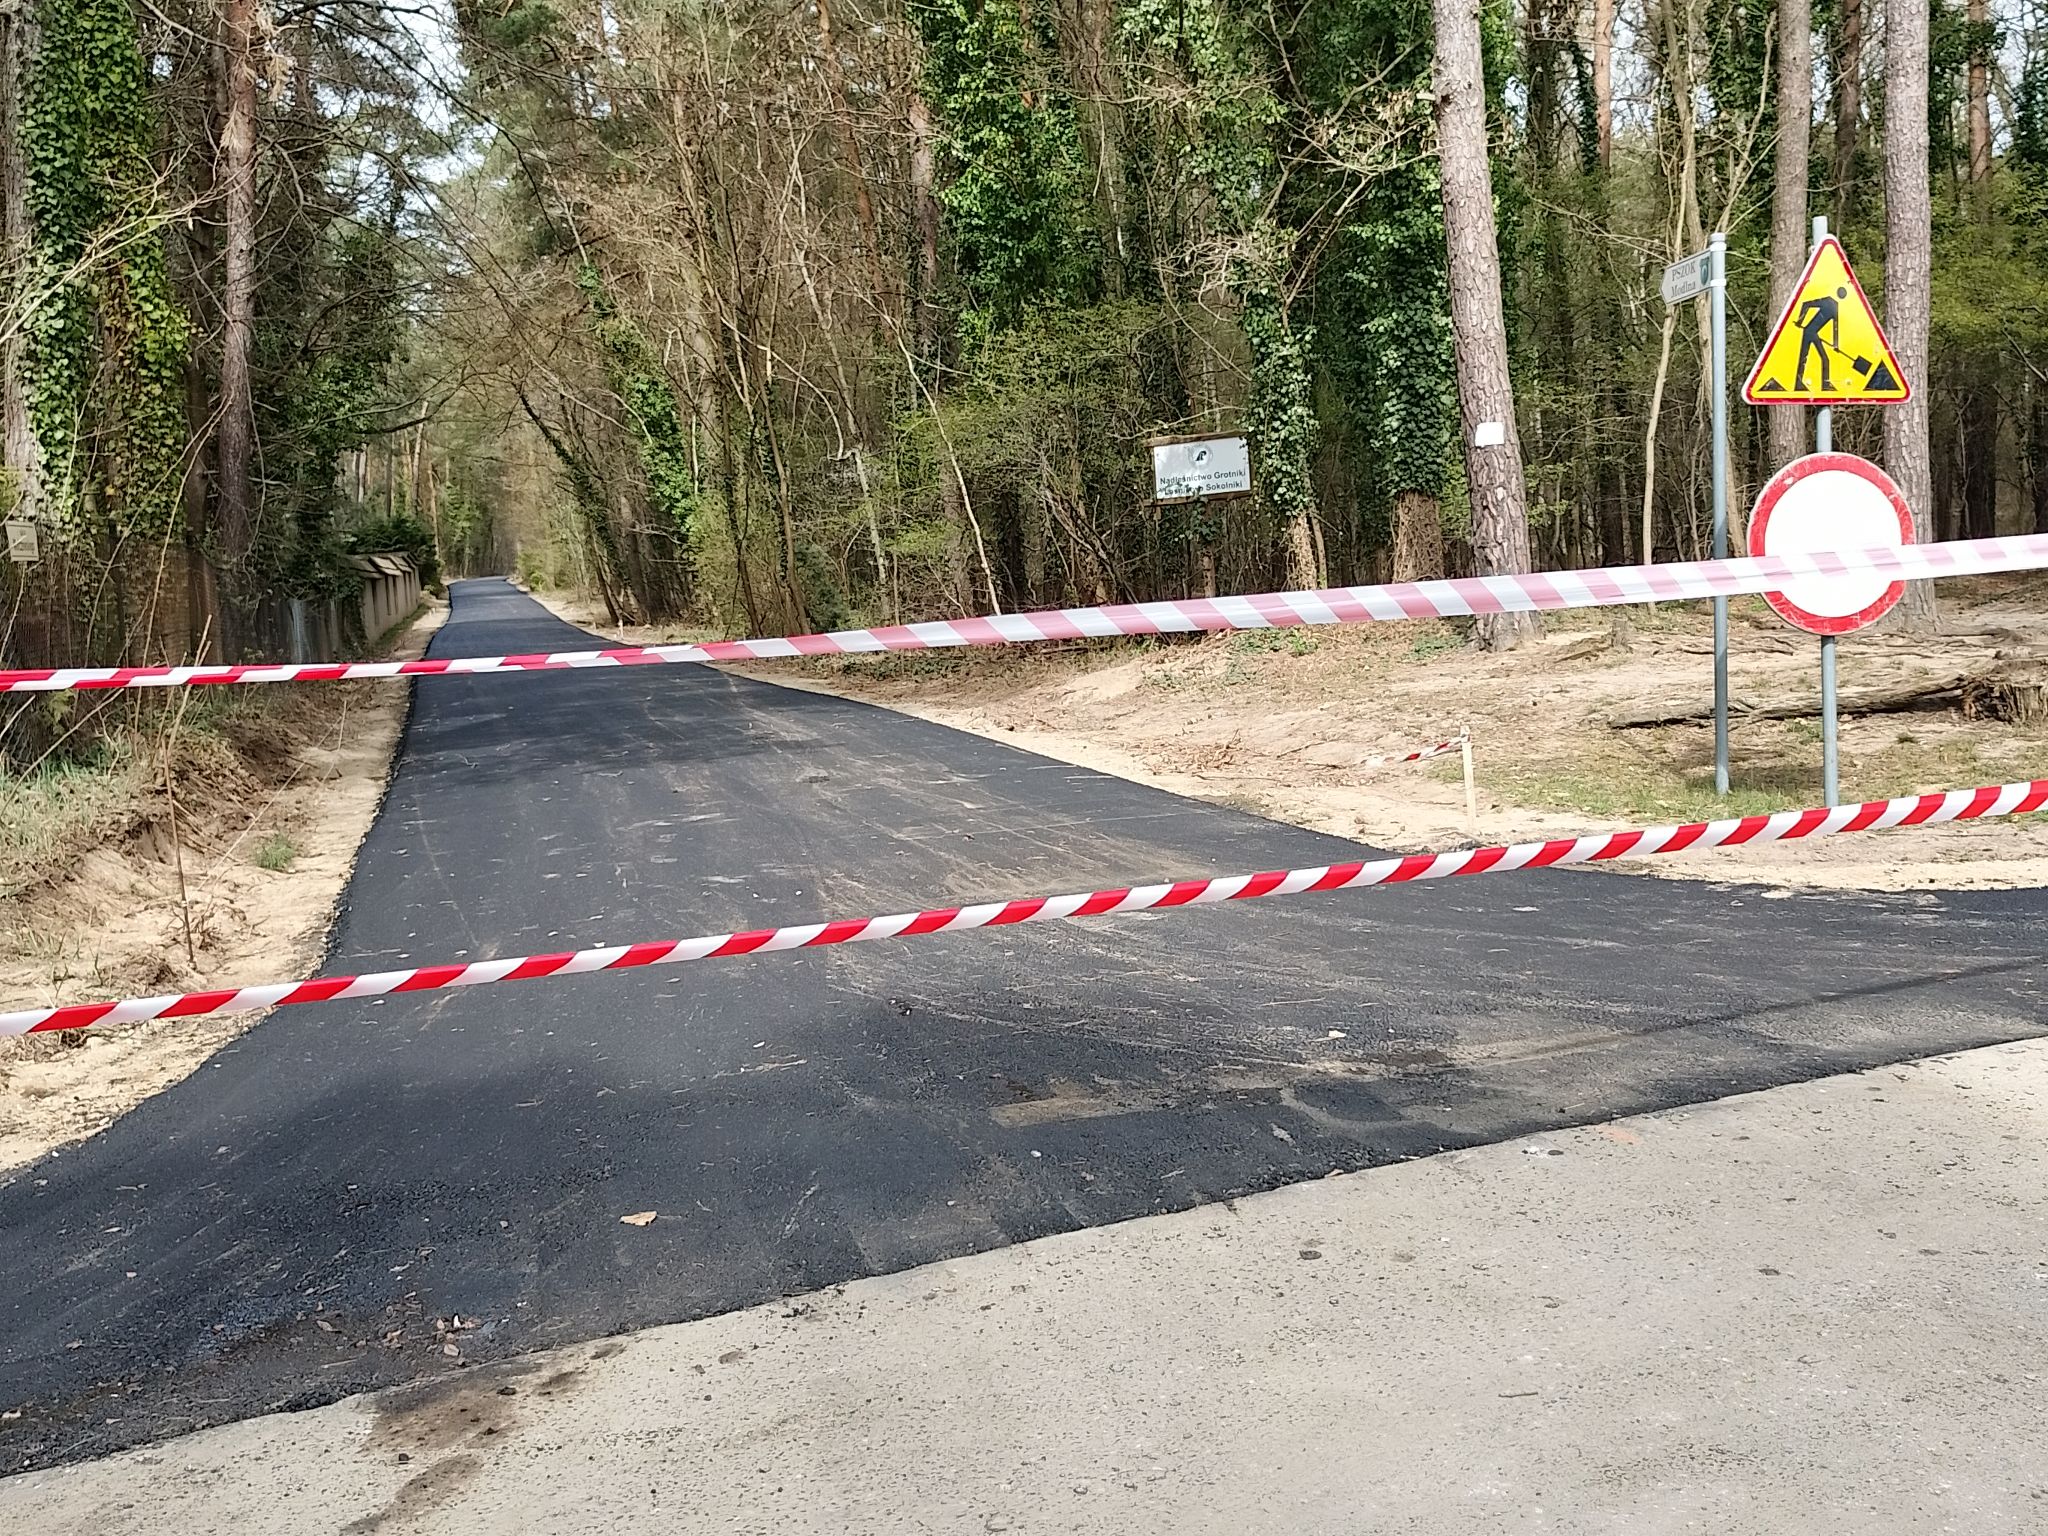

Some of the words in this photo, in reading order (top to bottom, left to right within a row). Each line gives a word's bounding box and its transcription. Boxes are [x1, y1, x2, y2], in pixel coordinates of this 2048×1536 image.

[1672, 261, 1696, 281] PSZOK
[1160, 473, 1212, 485] Nadleśnictwo
[1214, 469, 1246, 479] Grotniki
[1206, 481, 1243, 491] Sokolniki
